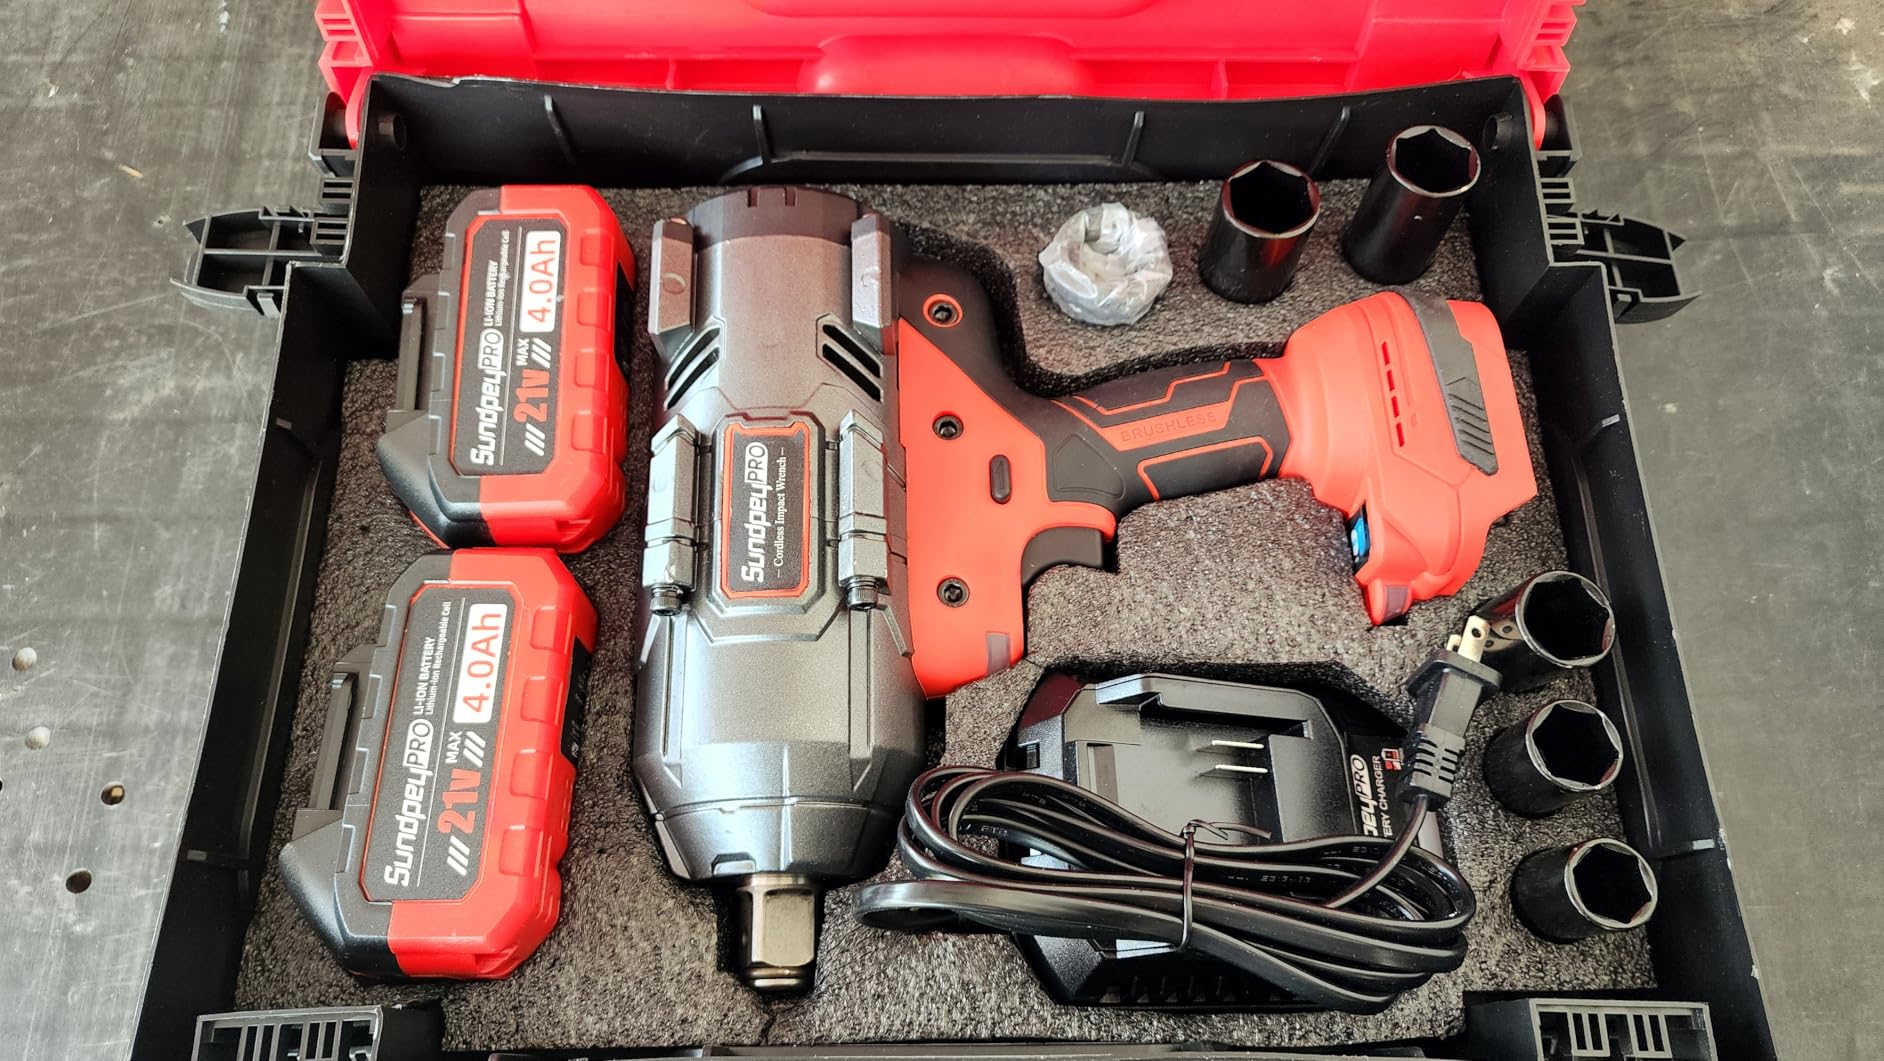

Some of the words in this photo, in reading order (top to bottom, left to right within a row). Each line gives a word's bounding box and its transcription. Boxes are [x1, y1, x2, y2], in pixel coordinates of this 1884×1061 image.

[486, 260, 498, 298] BATTERY
[527, 240, 556, 323] 4.0Ah
[483, 299, 496, 327] LI-ION
[515, 338, 530, 366] MAX
[1120, 411, 1217, 442] BRUSHLESS
[775, 457, 787, 492] Wrench
[775, 493, 787, 525] Impact
[774, 526, 785, 567] Cordless
[441, 601, 452, 616] Cell
[419, 636, 436, 681] BATTERY
[463, 613, 502, 713] 4.0Ah
[413, 682, 428, 715] LI-ION
[445, 731, 463, 764] MAX
[1371, 755, 1389, 811] CHARGER
